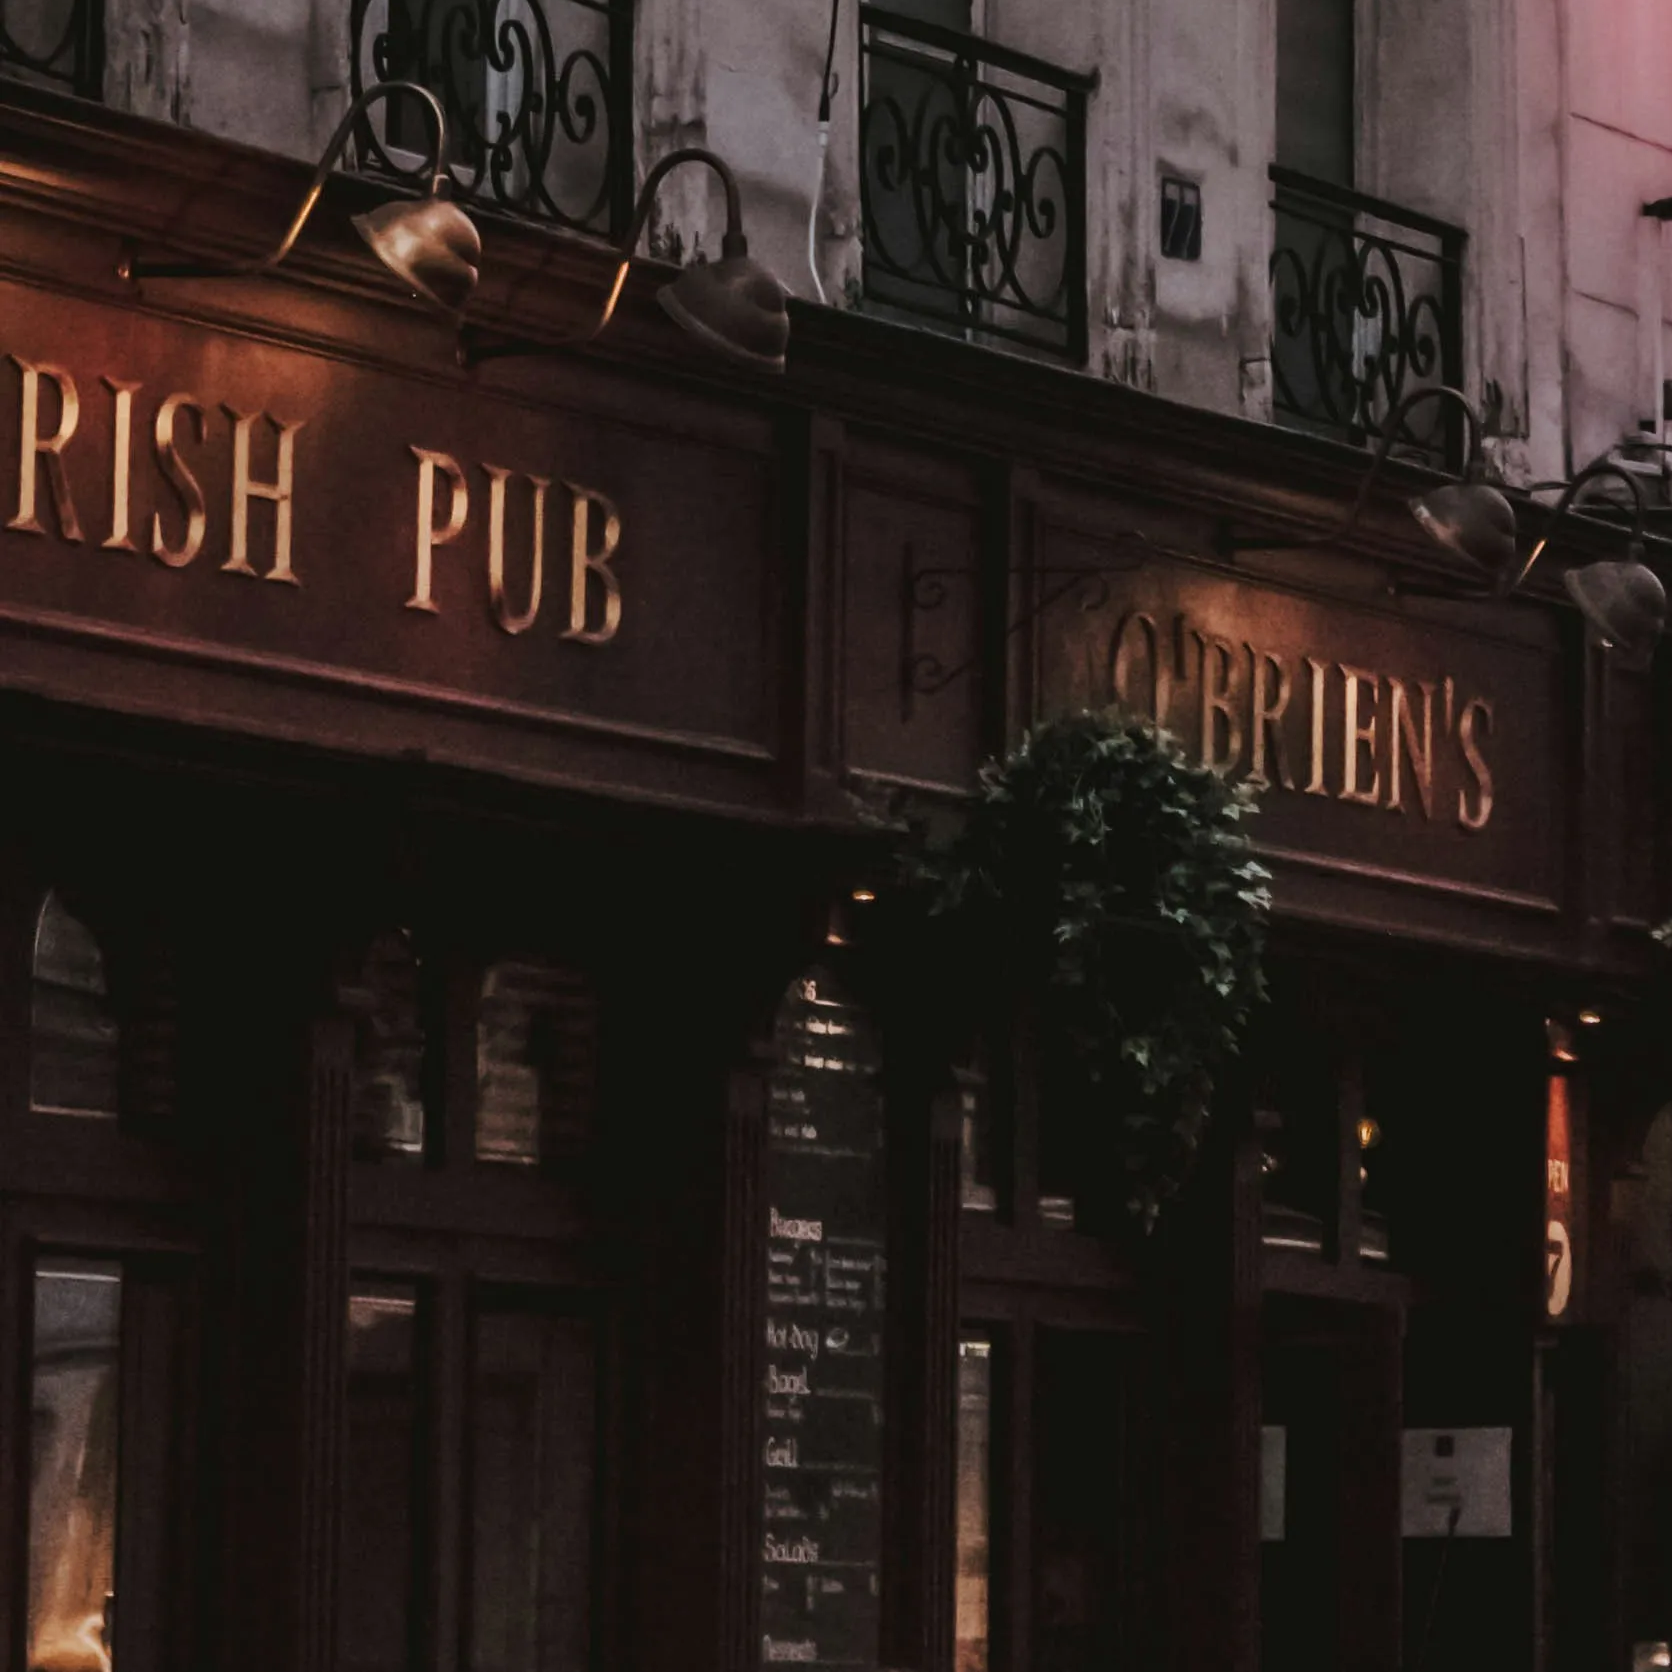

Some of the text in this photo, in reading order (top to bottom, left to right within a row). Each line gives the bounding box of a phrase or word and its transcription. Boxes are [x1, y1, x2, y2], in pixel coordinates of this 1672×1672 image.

[5, 354, 622, 645] RISH PUB
[1111, 611, 1494, 832] O'BRIEN'S
